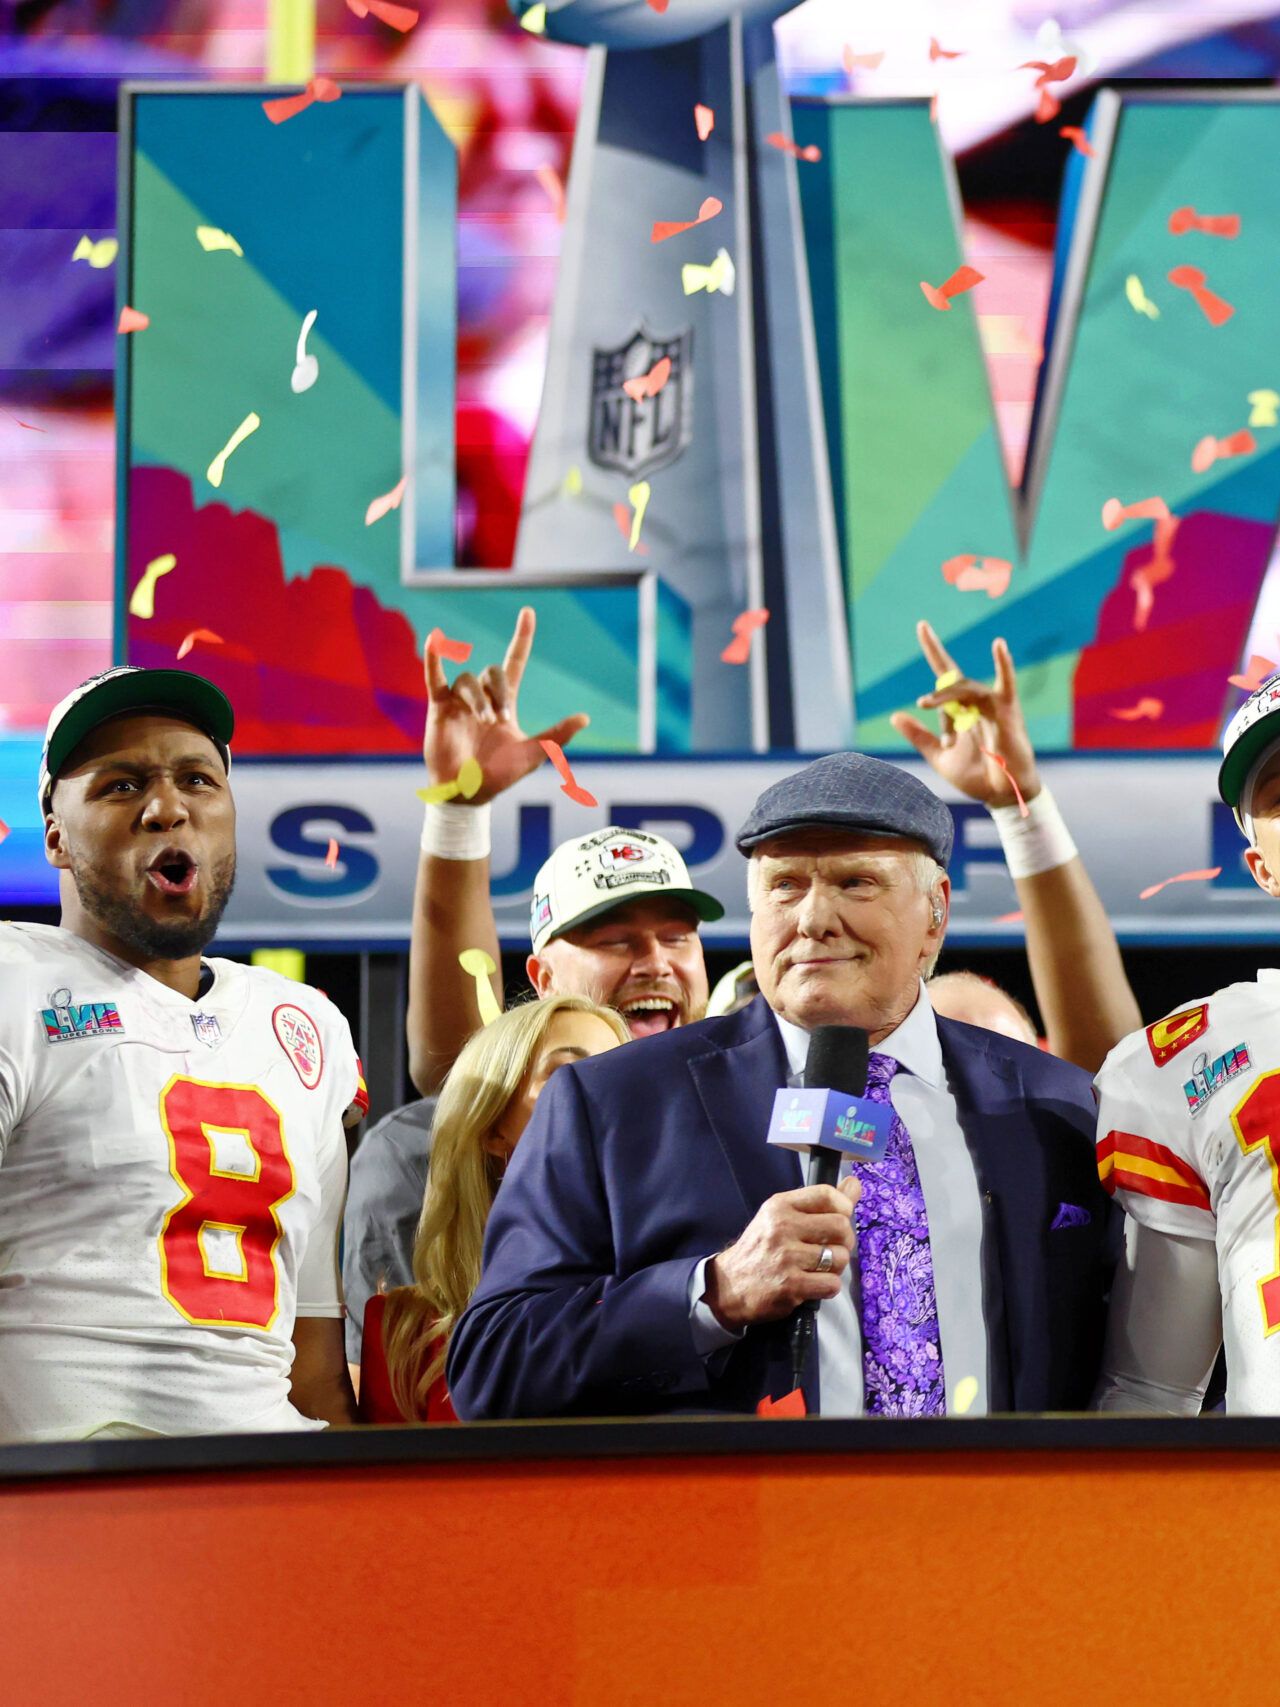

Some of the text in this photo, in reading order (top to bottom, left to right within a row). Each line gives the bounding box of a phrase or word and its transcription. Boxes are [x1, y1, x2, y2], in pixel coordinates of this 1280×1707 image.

[600, 394, 674, 458] NFL
[56, 1026, 119, 1041] SUPER BOWL
[200, 1024, 219, 1037] NFL
[1151, 1006, 1203, 1049] C
[158, 1073, 297, 1332] 8
